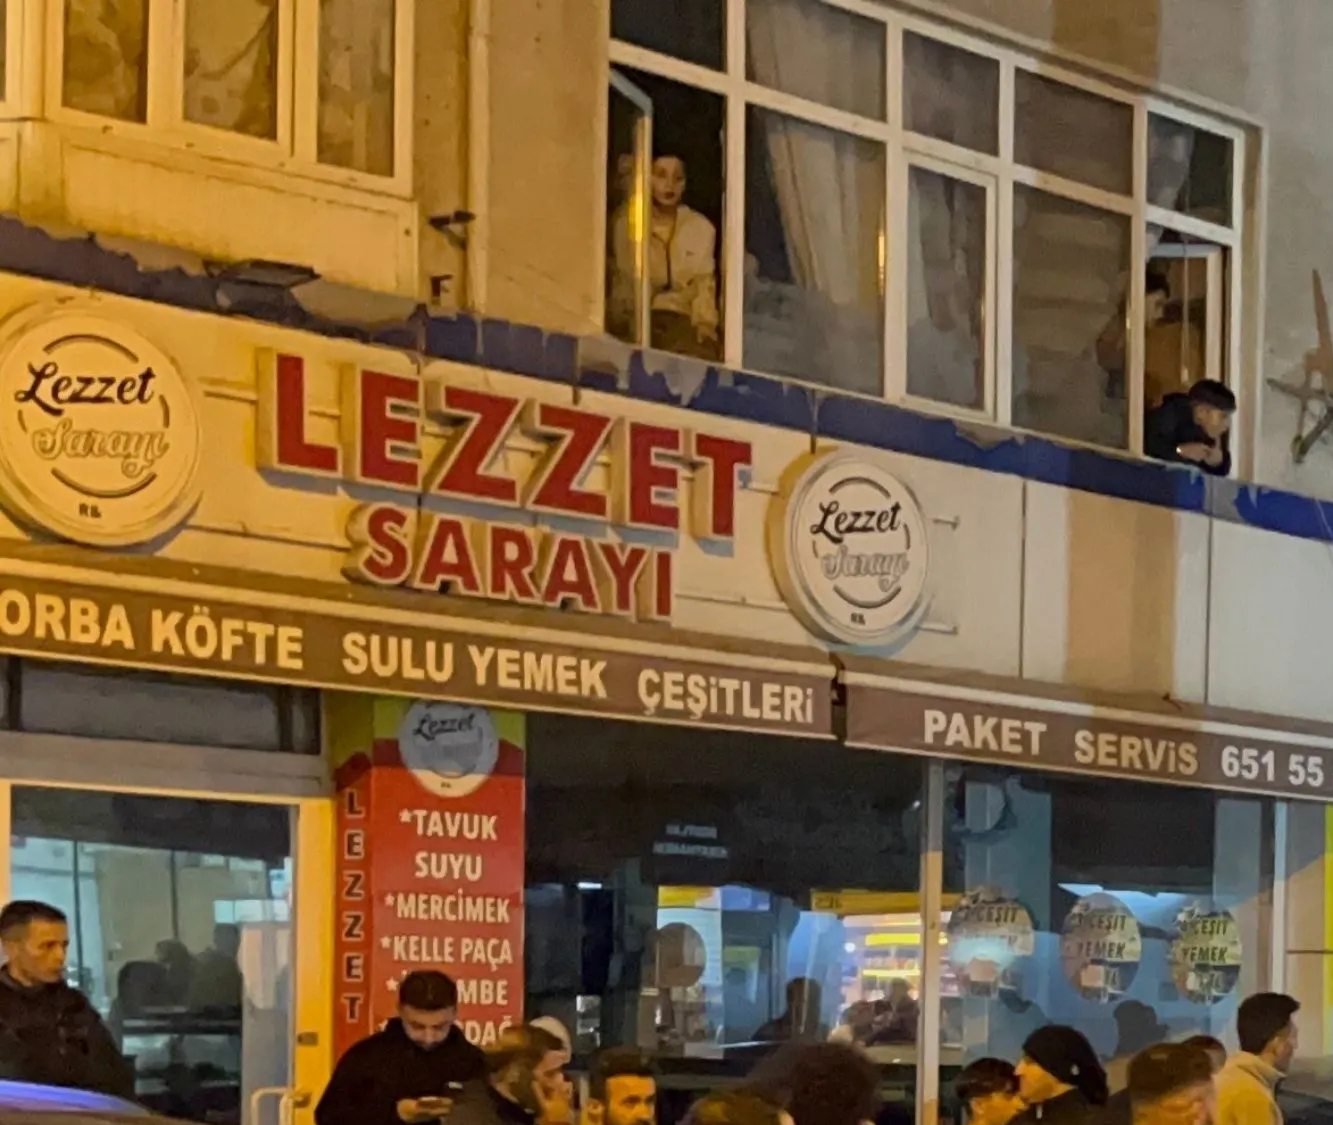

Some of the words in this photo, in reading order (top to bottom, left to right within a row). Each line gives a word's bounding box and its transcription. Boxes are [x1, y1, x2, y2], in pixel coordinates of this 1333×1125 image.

[14, 361, 156, 417] Lezzet
[274, 351, 754, 540] LEZZET
[810, 500, 901, 544] Lezzet
[361, 504, 674, 618] SARAYI
[150, 604, 305, 670] KÖFTE
[341, 631, 455, 683] SULU
[468, 644, 608, 699] YEMEK
[923, 708, 1047, 756] PAKET
[1221, 745, 1275, 783] 651
[1288, 756, 1324, 788] 55
[412, 808, 499, 841] TAVUK
[415, 851, 482, 882] SUYU
[460, 937, 514, 972] PAÇA
